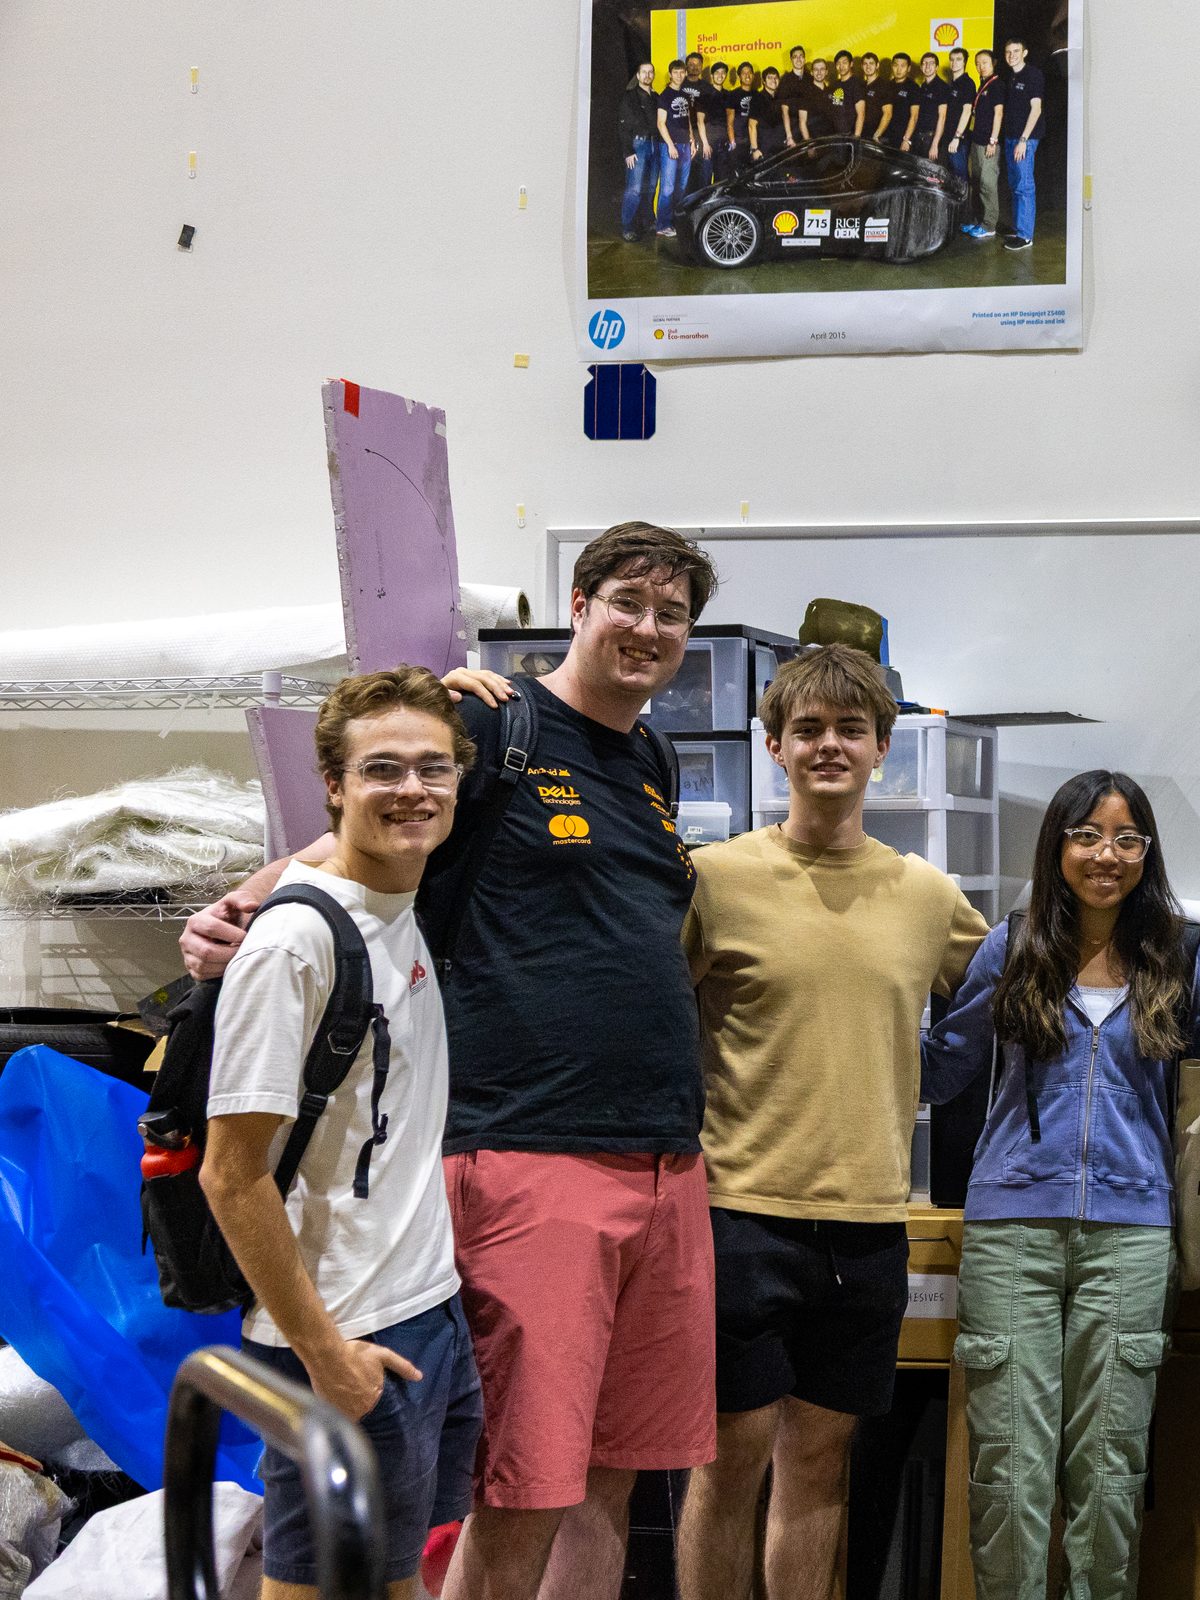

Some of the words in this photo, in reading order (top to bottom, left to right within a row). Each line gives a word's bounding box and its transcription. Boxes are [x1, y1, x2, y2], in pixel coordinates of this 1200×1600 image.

[697, 33, 718, 42] Shell
[697, 38, 782, 54] Eco-marathon
[807, 218, 827, 229] 715
[835, 217, 860, 228] RICE
[593, 310, 620, 350] hp
[810, 332, 827, 341] April
[828, 331, 846, 340] 2015
[537, 785, 580, 798] DELL
[541, 797, 581, 806] Technologies
